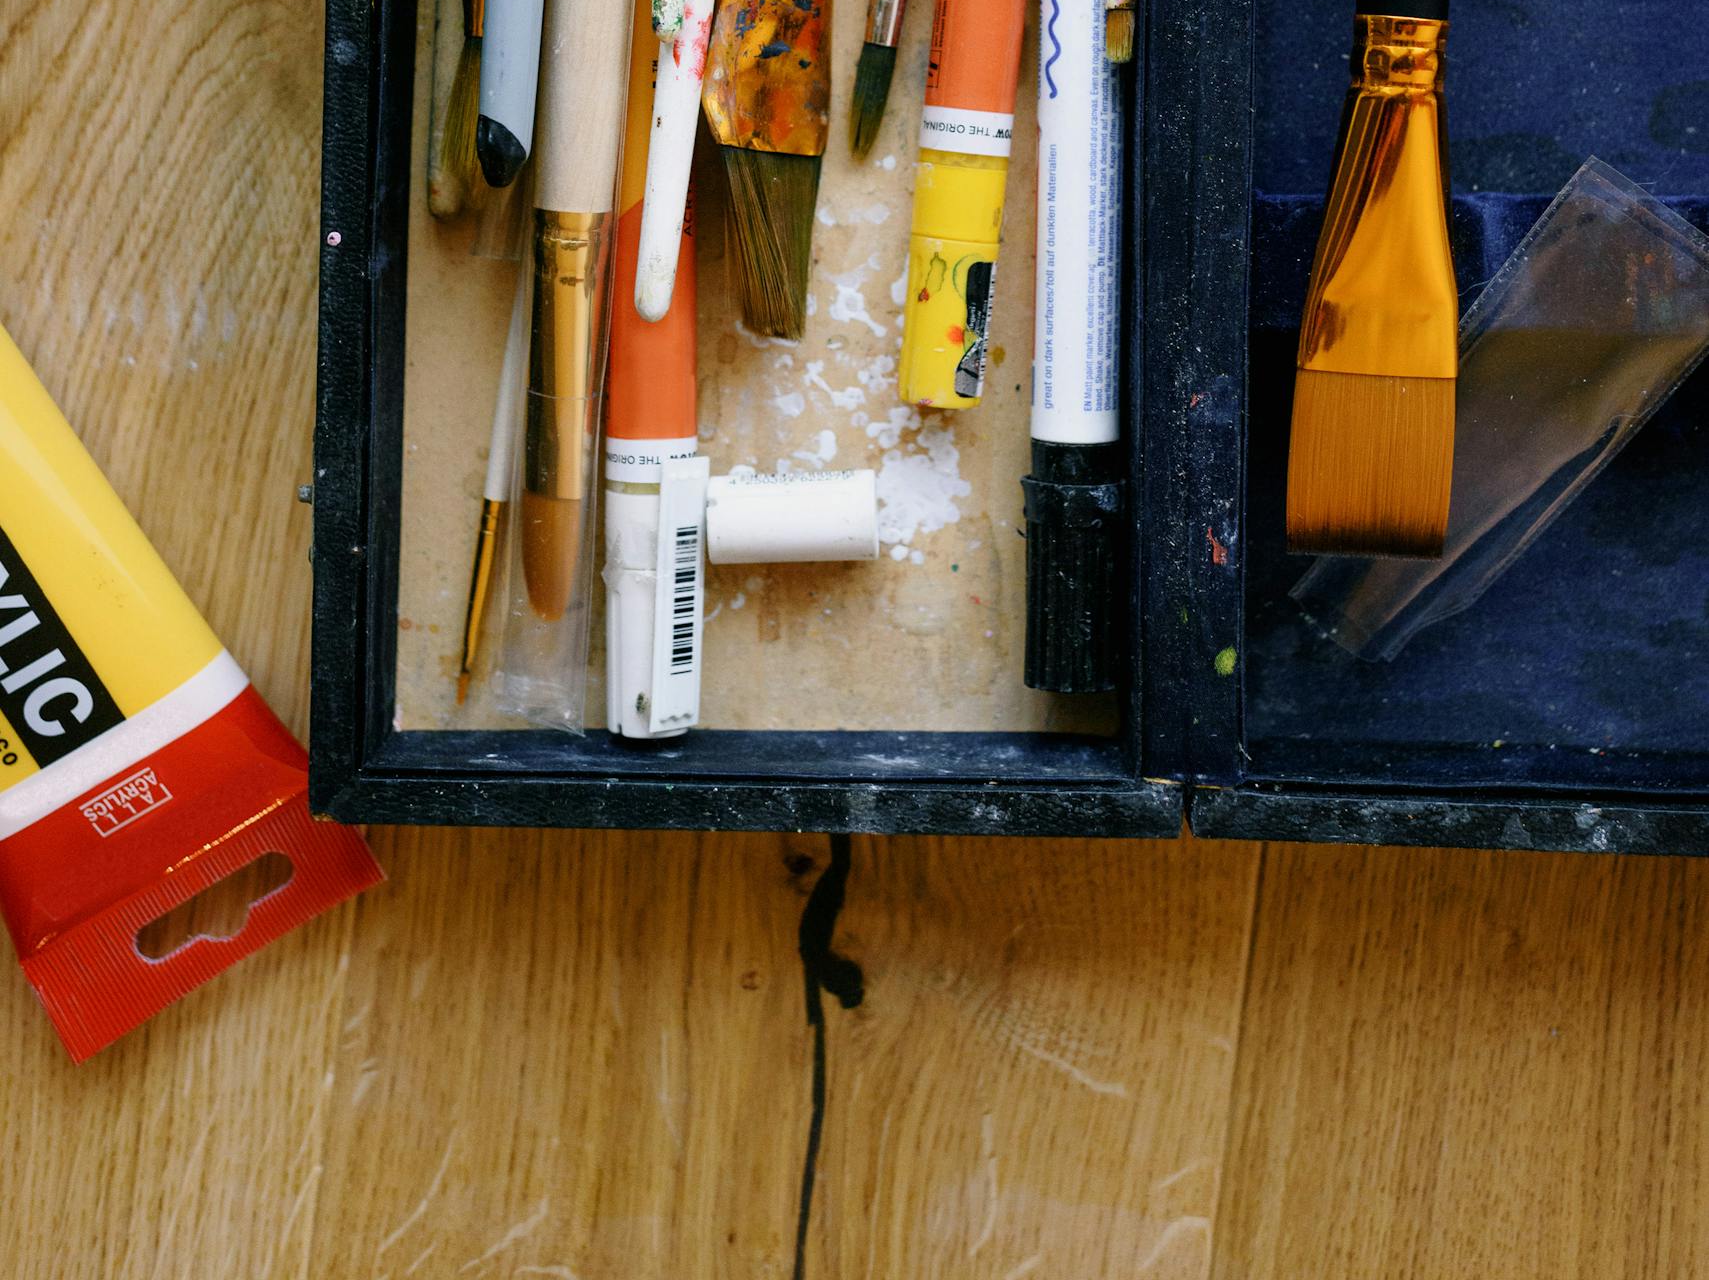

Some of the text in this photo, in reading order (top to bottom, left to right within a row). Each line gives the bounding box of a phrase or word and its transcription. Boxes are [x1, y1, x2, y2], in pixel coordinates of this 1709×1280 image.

[1091, 24, 1099, 40] dark
[1091, 42, 1101, 63] rough
[1091, 65, 1098, 75] on
[1090, 76, 1098, 95] Even
[968, 124, 991, 137] THE
[1089, 127, 1097, 140] and
[1089, 142, 1097, 180] cardboard
[1098, 256, 1104, 266] DE
[1043, 143, 1056, 408] great on dark surfaces/toll auf dunklen Materialien
[1086, 294, 1094, 328] excellent
[1085, 360, 1093, 378] paint
[1084, 400, 1092, 411] EN
[638, 455, 661, 465] THE
[84, 769, 158, 822] ACRYLICS
[104, 791, 154, 824] ALL
